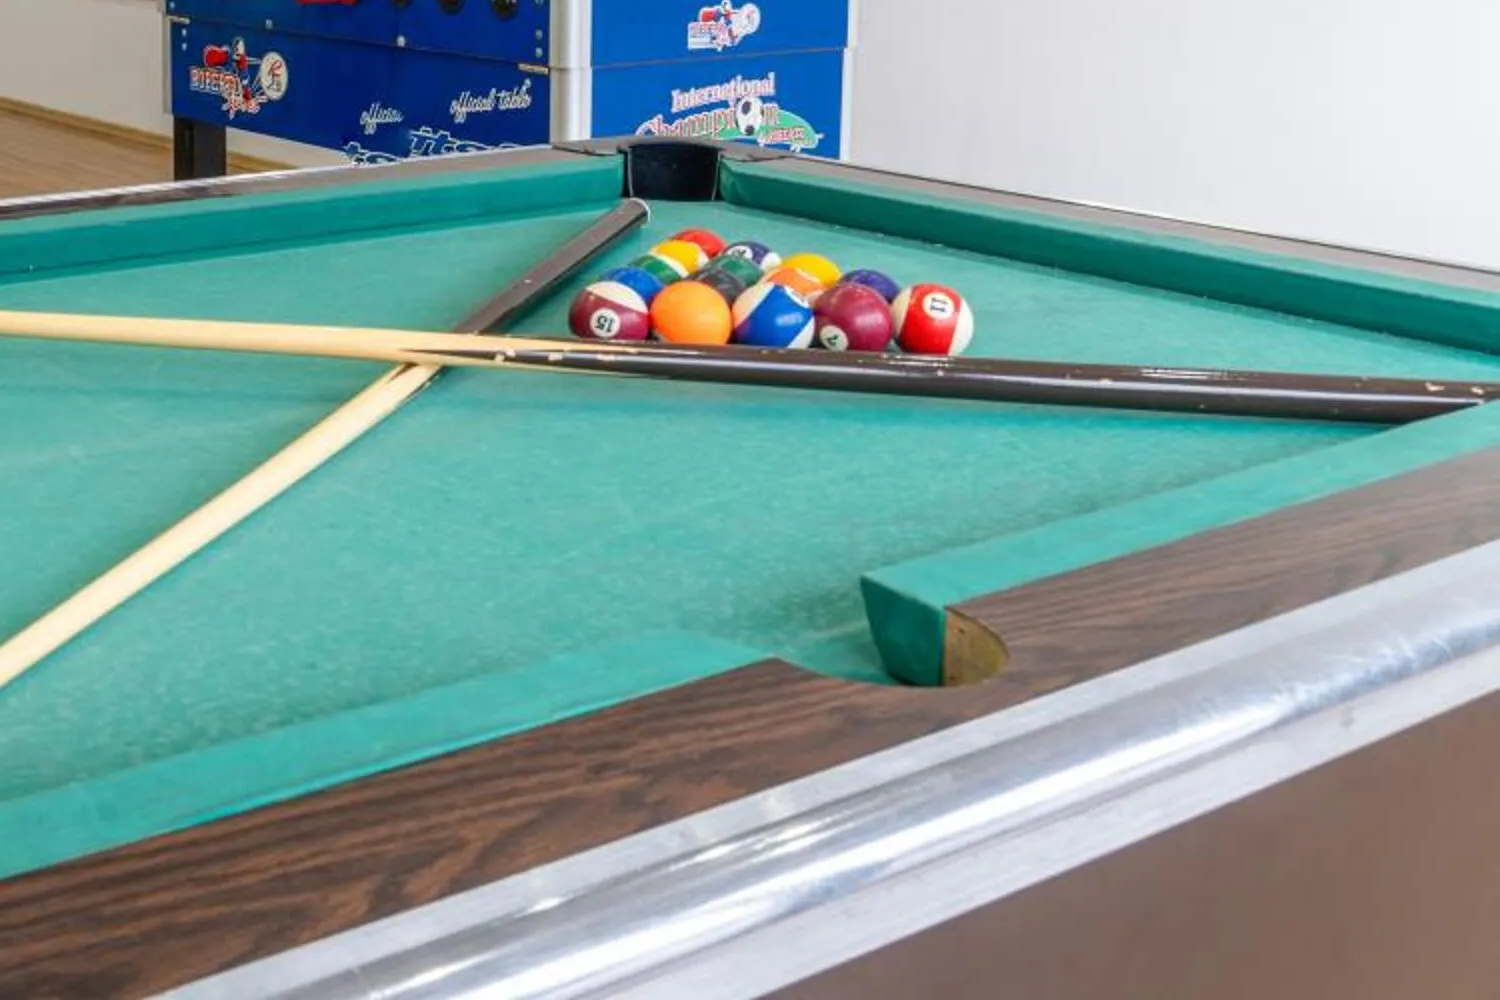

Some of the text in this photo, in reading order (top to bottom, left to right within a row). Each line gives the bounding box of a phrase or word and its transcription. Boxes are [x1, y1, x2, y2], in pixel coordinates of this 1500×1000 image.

[450, 77, 532, 123] official table
[671, 72, 776, 113] International
[930, 297, 948, 313] 11
[595, 315, 615, 333] 15
